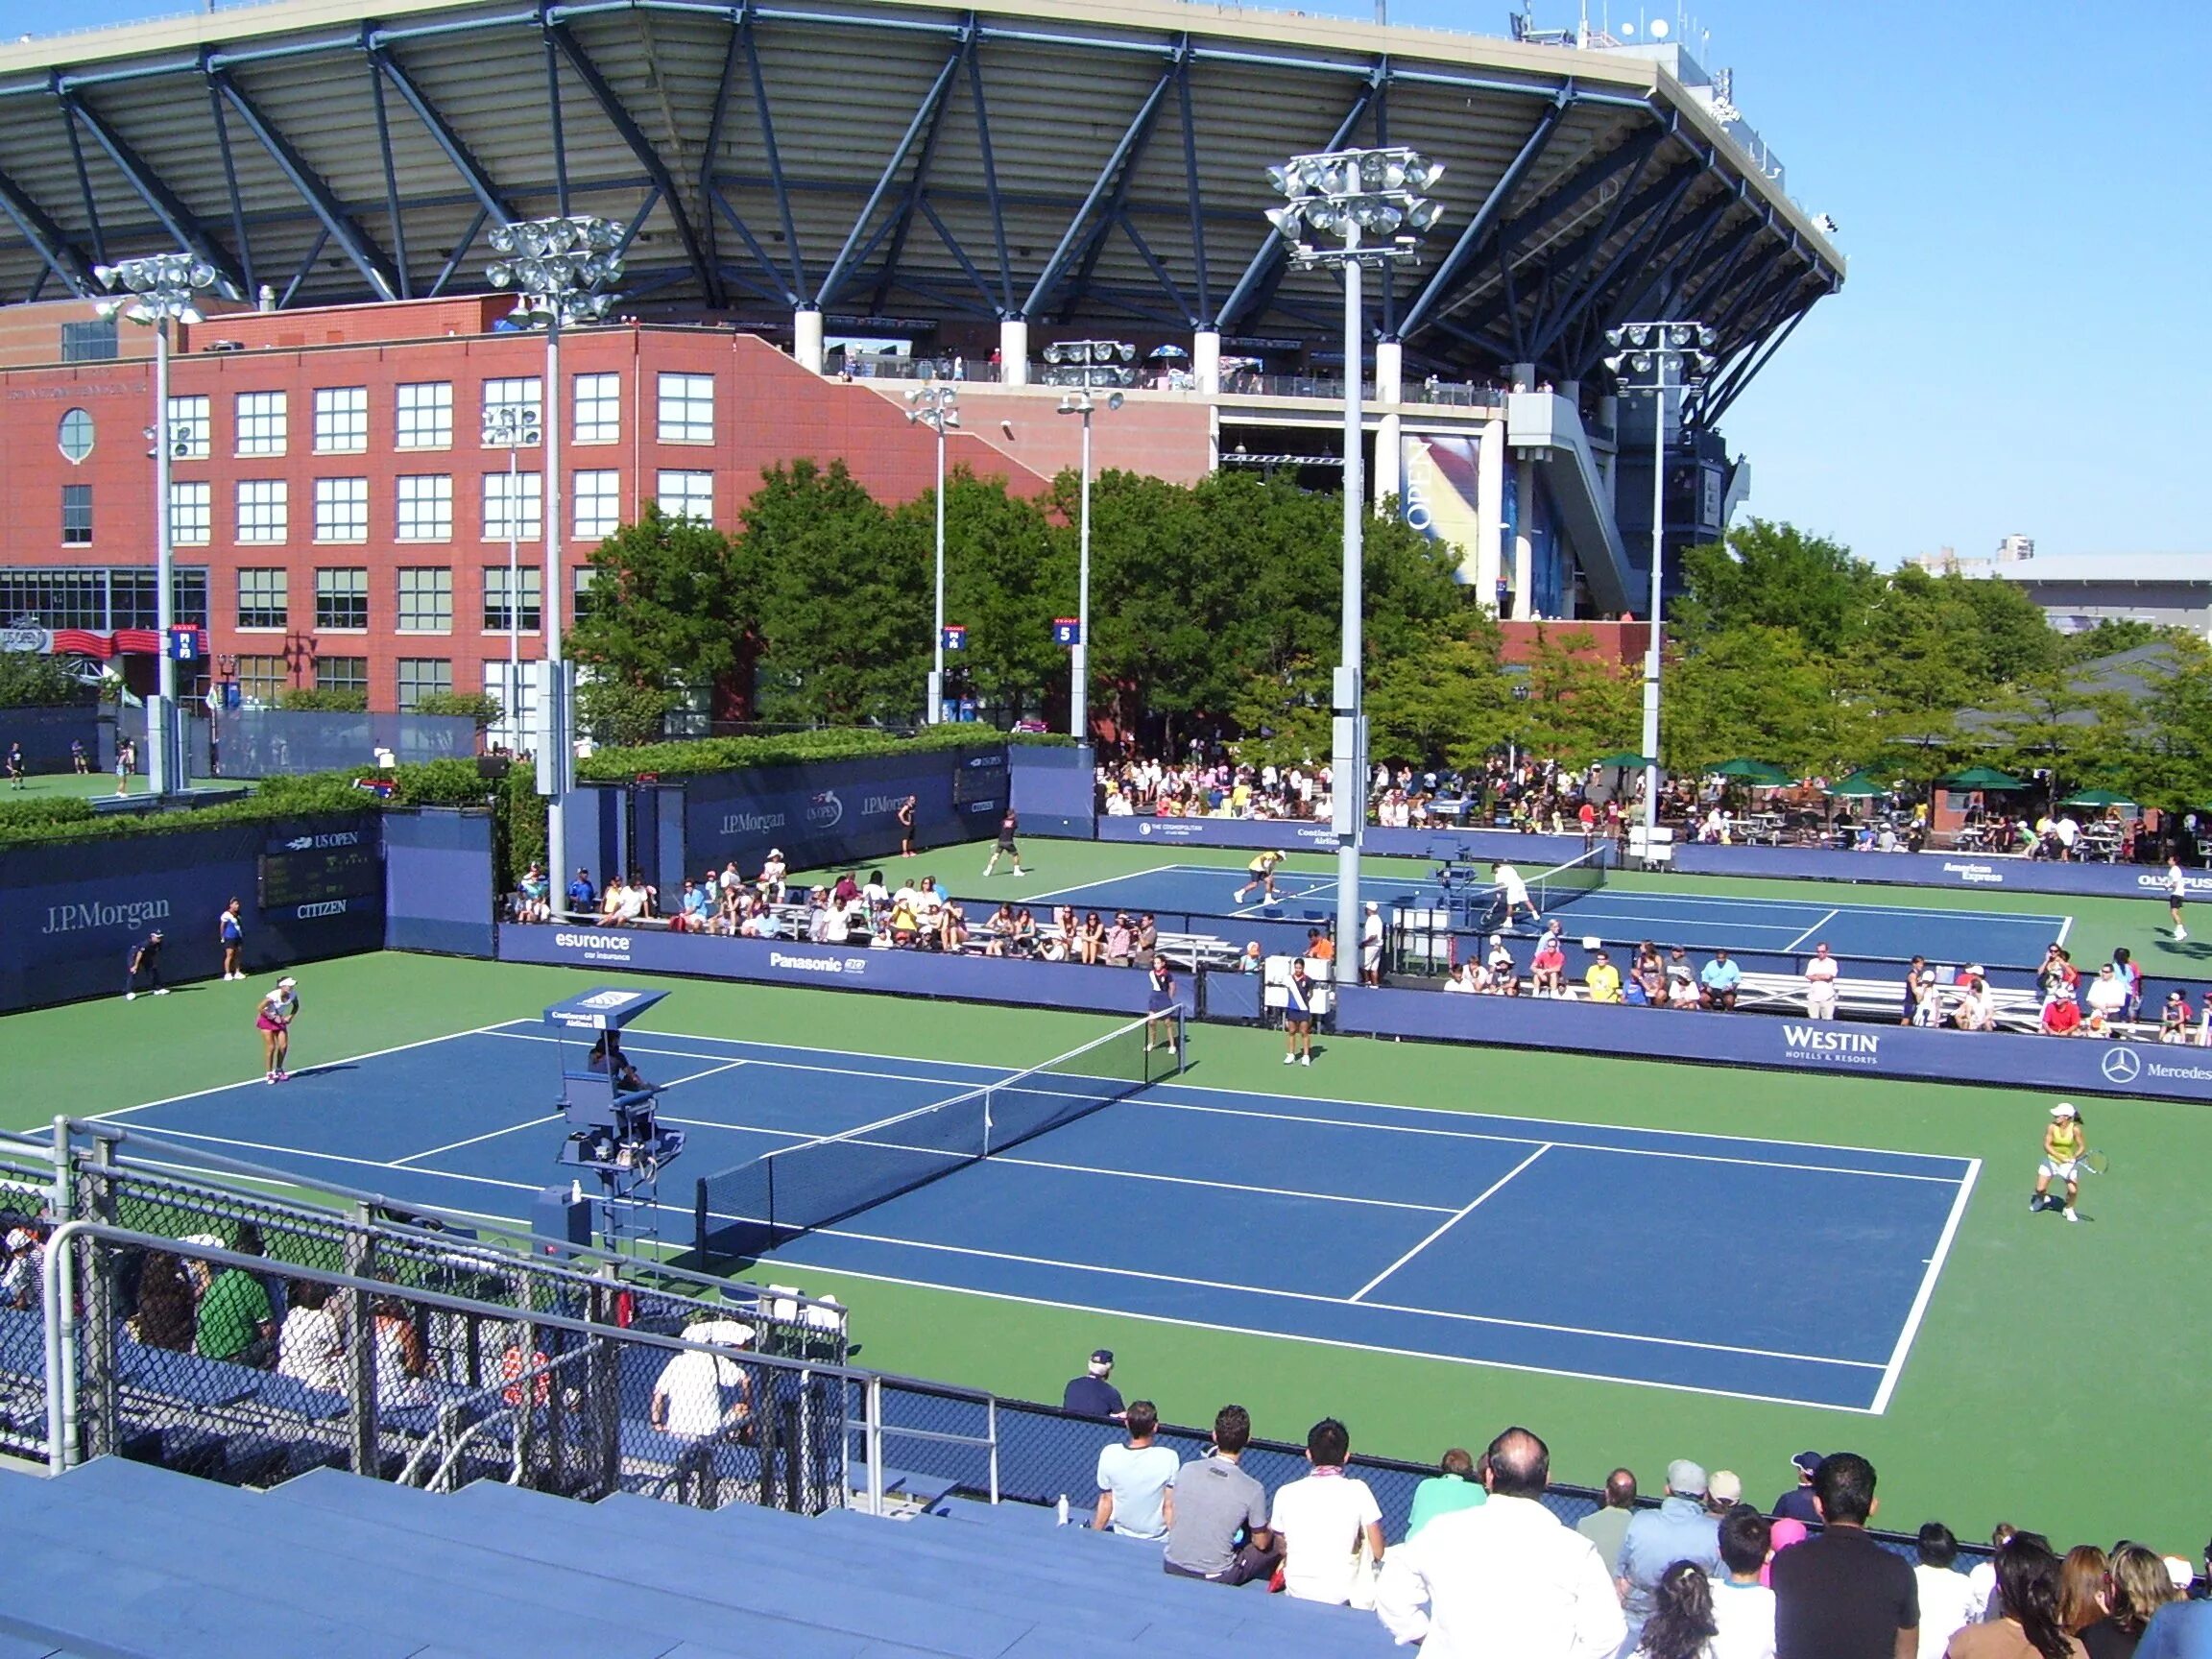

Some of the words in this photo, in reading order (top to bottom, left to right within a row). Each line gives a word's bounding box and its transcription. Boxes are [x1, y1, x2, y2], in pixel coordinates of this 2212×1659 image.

[1407, 443, 1432, 530] OPEN
[1060, 627, 1070, 641] 5
[720, 812, 785, 834] J.P.Morgan
[315, 834, 329, 849] US
[329, 830, 359, 847] OPEN
[2138, 875, 2212, 889] OLYPUS
[42, 899, 170, 934] J.P.Morgan
[297, 900, 348, 919] CITIZEN
[555, 933, 630, 950] esurance
[596, 950, 631, 961] insurance
[770, 951, 843, 973] Panasonic
[1783, 1024, 1878, 1053] WESTIN
[1786, 1051, 1821, 1061] HOTELS
[1835, 1054, 1878, 1065] RESORTS
